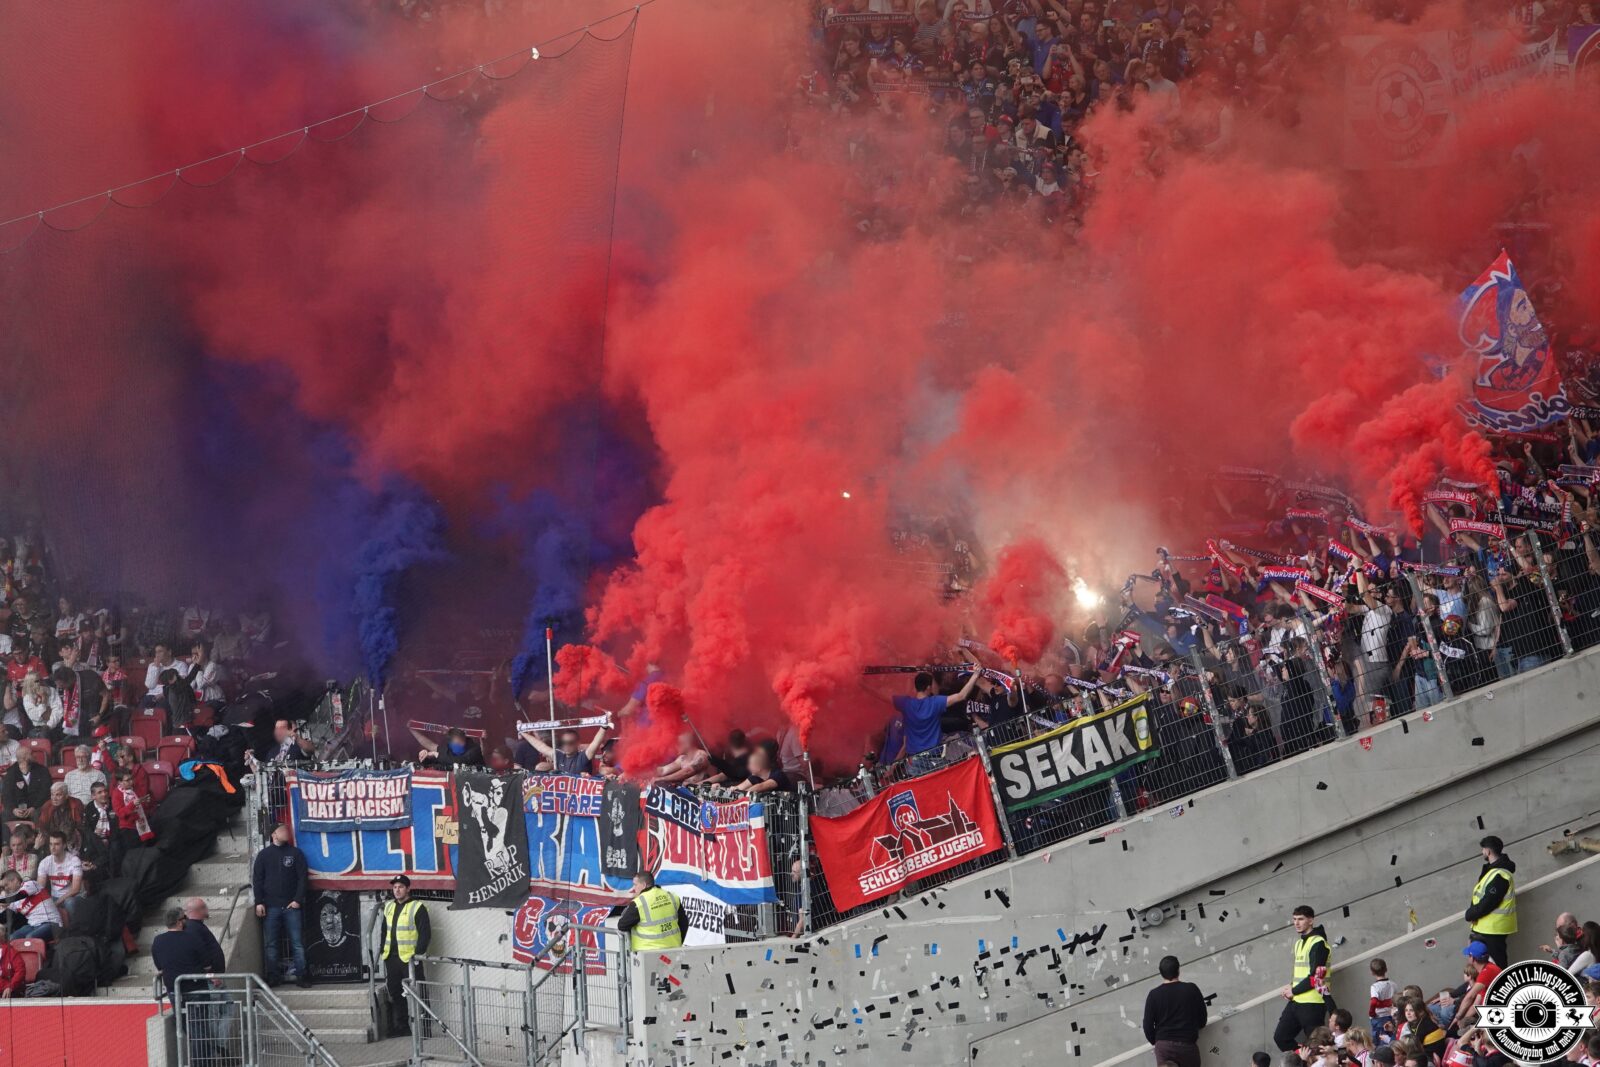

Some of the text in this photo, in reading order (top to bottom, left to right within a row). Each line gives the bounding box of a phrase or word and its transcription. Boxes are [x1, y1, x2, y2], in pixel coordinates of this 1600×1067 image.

[301, 778, 409, 800] LOVE FOOTBALL
[307, 797, 404, 818] HATE RACISM
[541, 791, 602, 814] STARS
[671, 793, 702, 831] CRE
[898, 810, 916, 828] FCH
[859, 831, 984, 893] SCHLOSSBERG JUGEND
[468, 863, 526, 904] HENDRIK
[681, 896, 724, 918] KLEINSTADT
[685, 911, 723, 935] RIEGER
